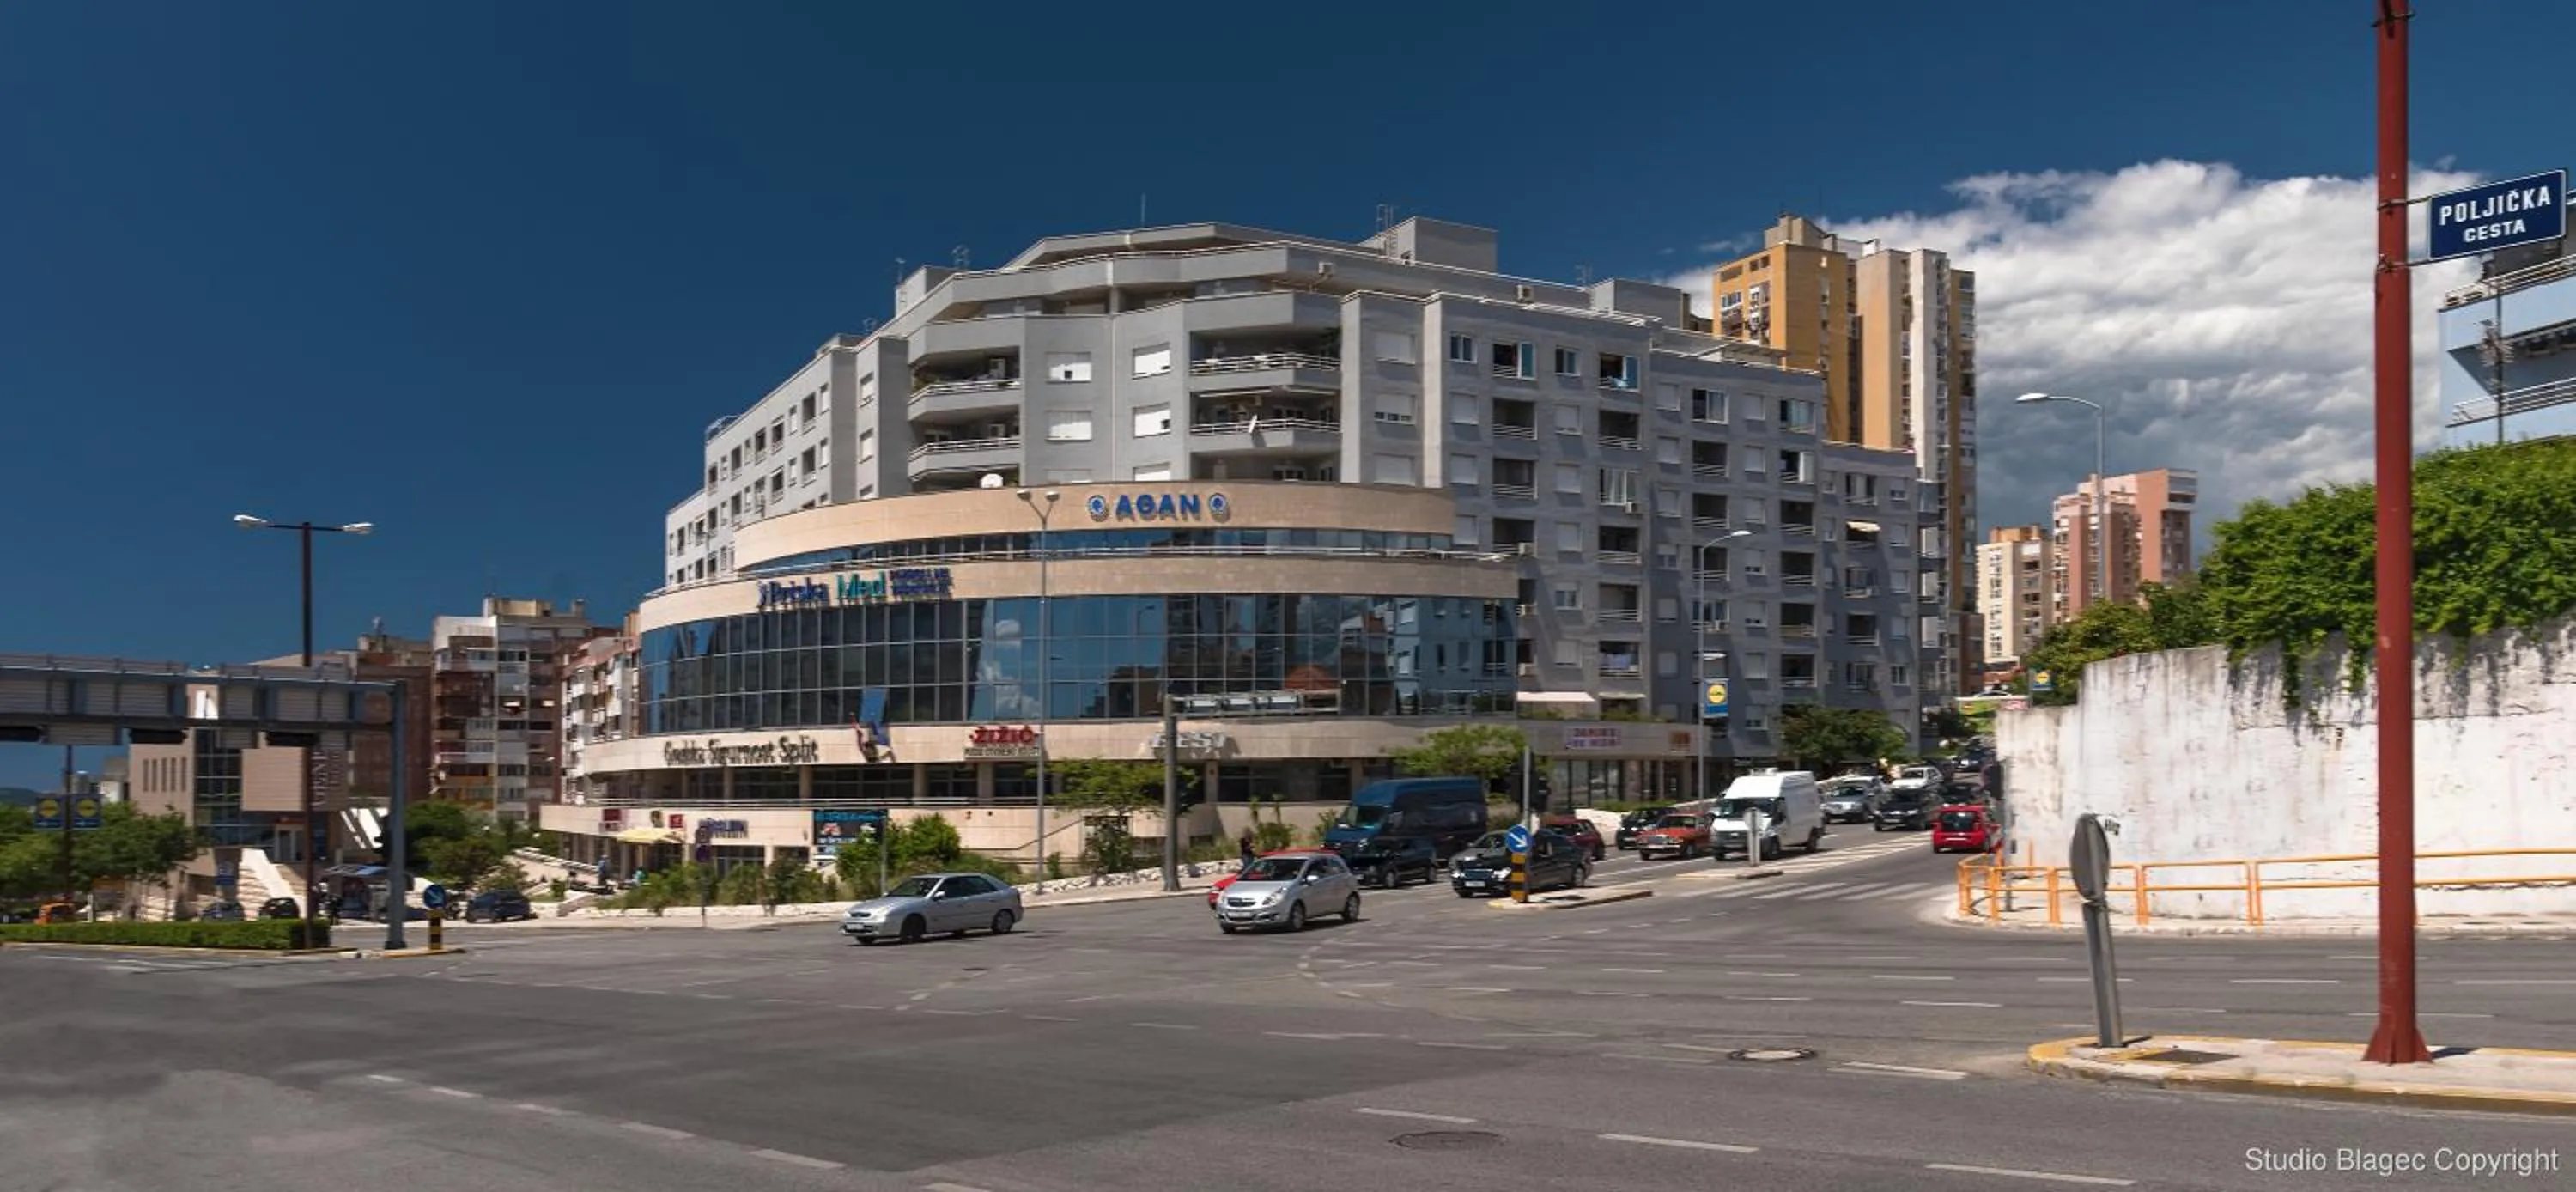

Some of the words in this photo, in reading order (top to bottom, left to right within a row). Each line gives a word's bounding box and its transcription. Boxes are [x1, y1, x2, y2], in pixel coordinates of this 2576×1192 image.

[2439, 185, 2551, 226] POLJIČKA
[2464, 218, 2526, 243] CESTA
[836, 567, 886, 599] Med
[779, 734, 819, 766] Split
